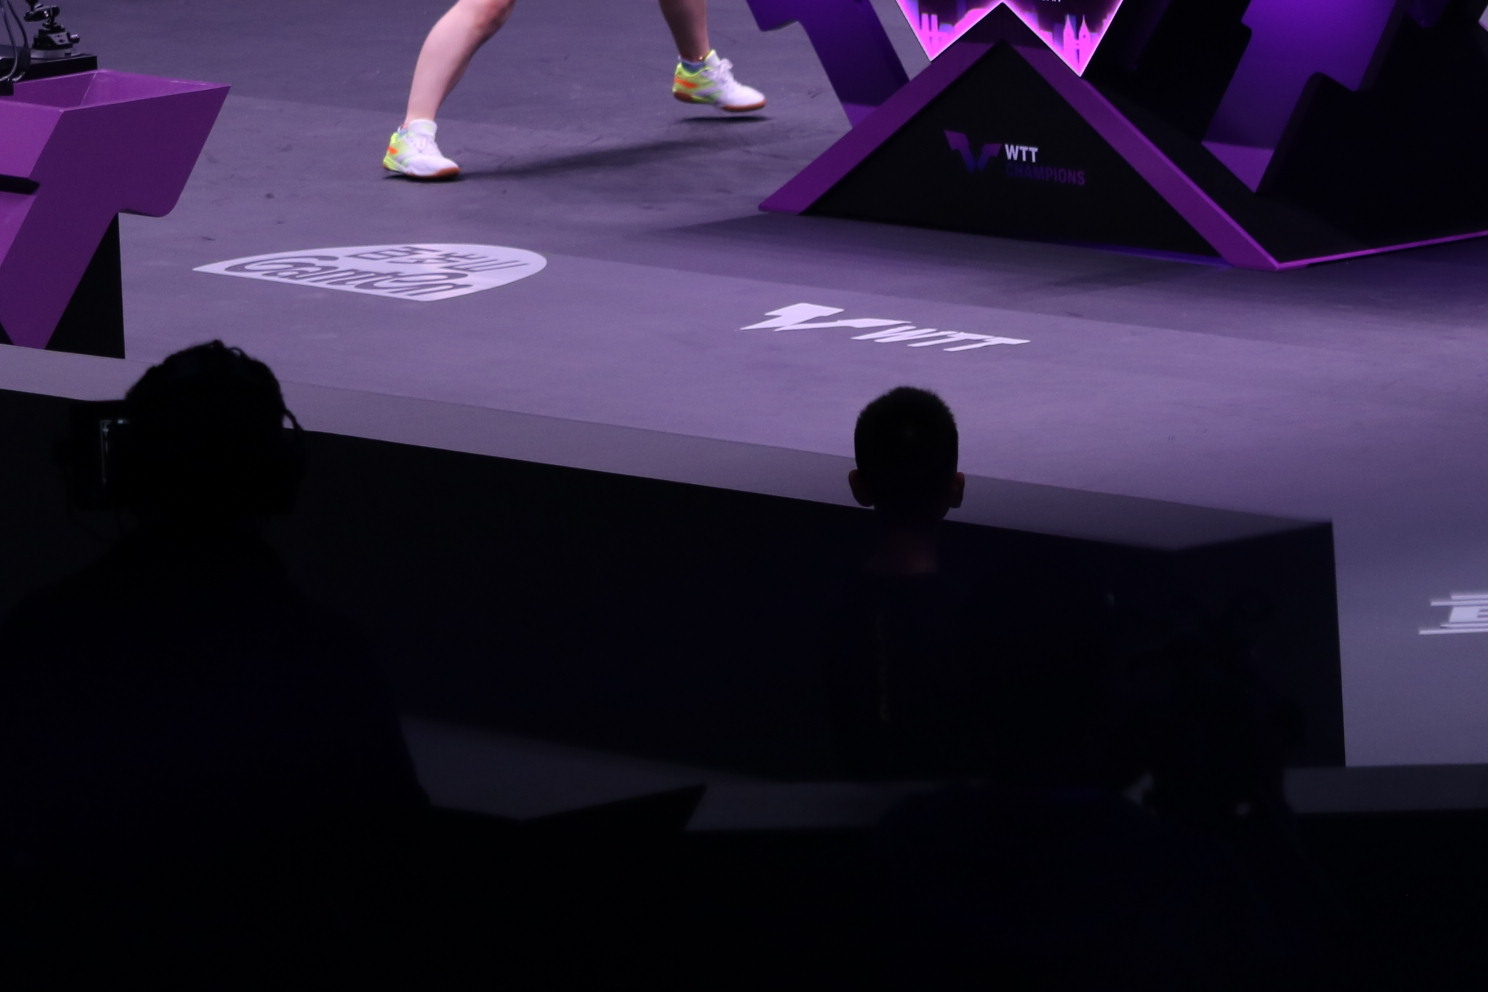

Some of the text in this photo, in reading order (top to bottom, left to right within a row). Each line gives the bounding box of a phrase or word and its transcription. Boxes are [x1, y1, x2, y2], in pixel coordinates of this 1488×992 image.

[1004, 142, 1039, 163] WTT
[1005, 162, 1087, 187] CHAMPIONS
[850, 324, 1032, 352] WTT
